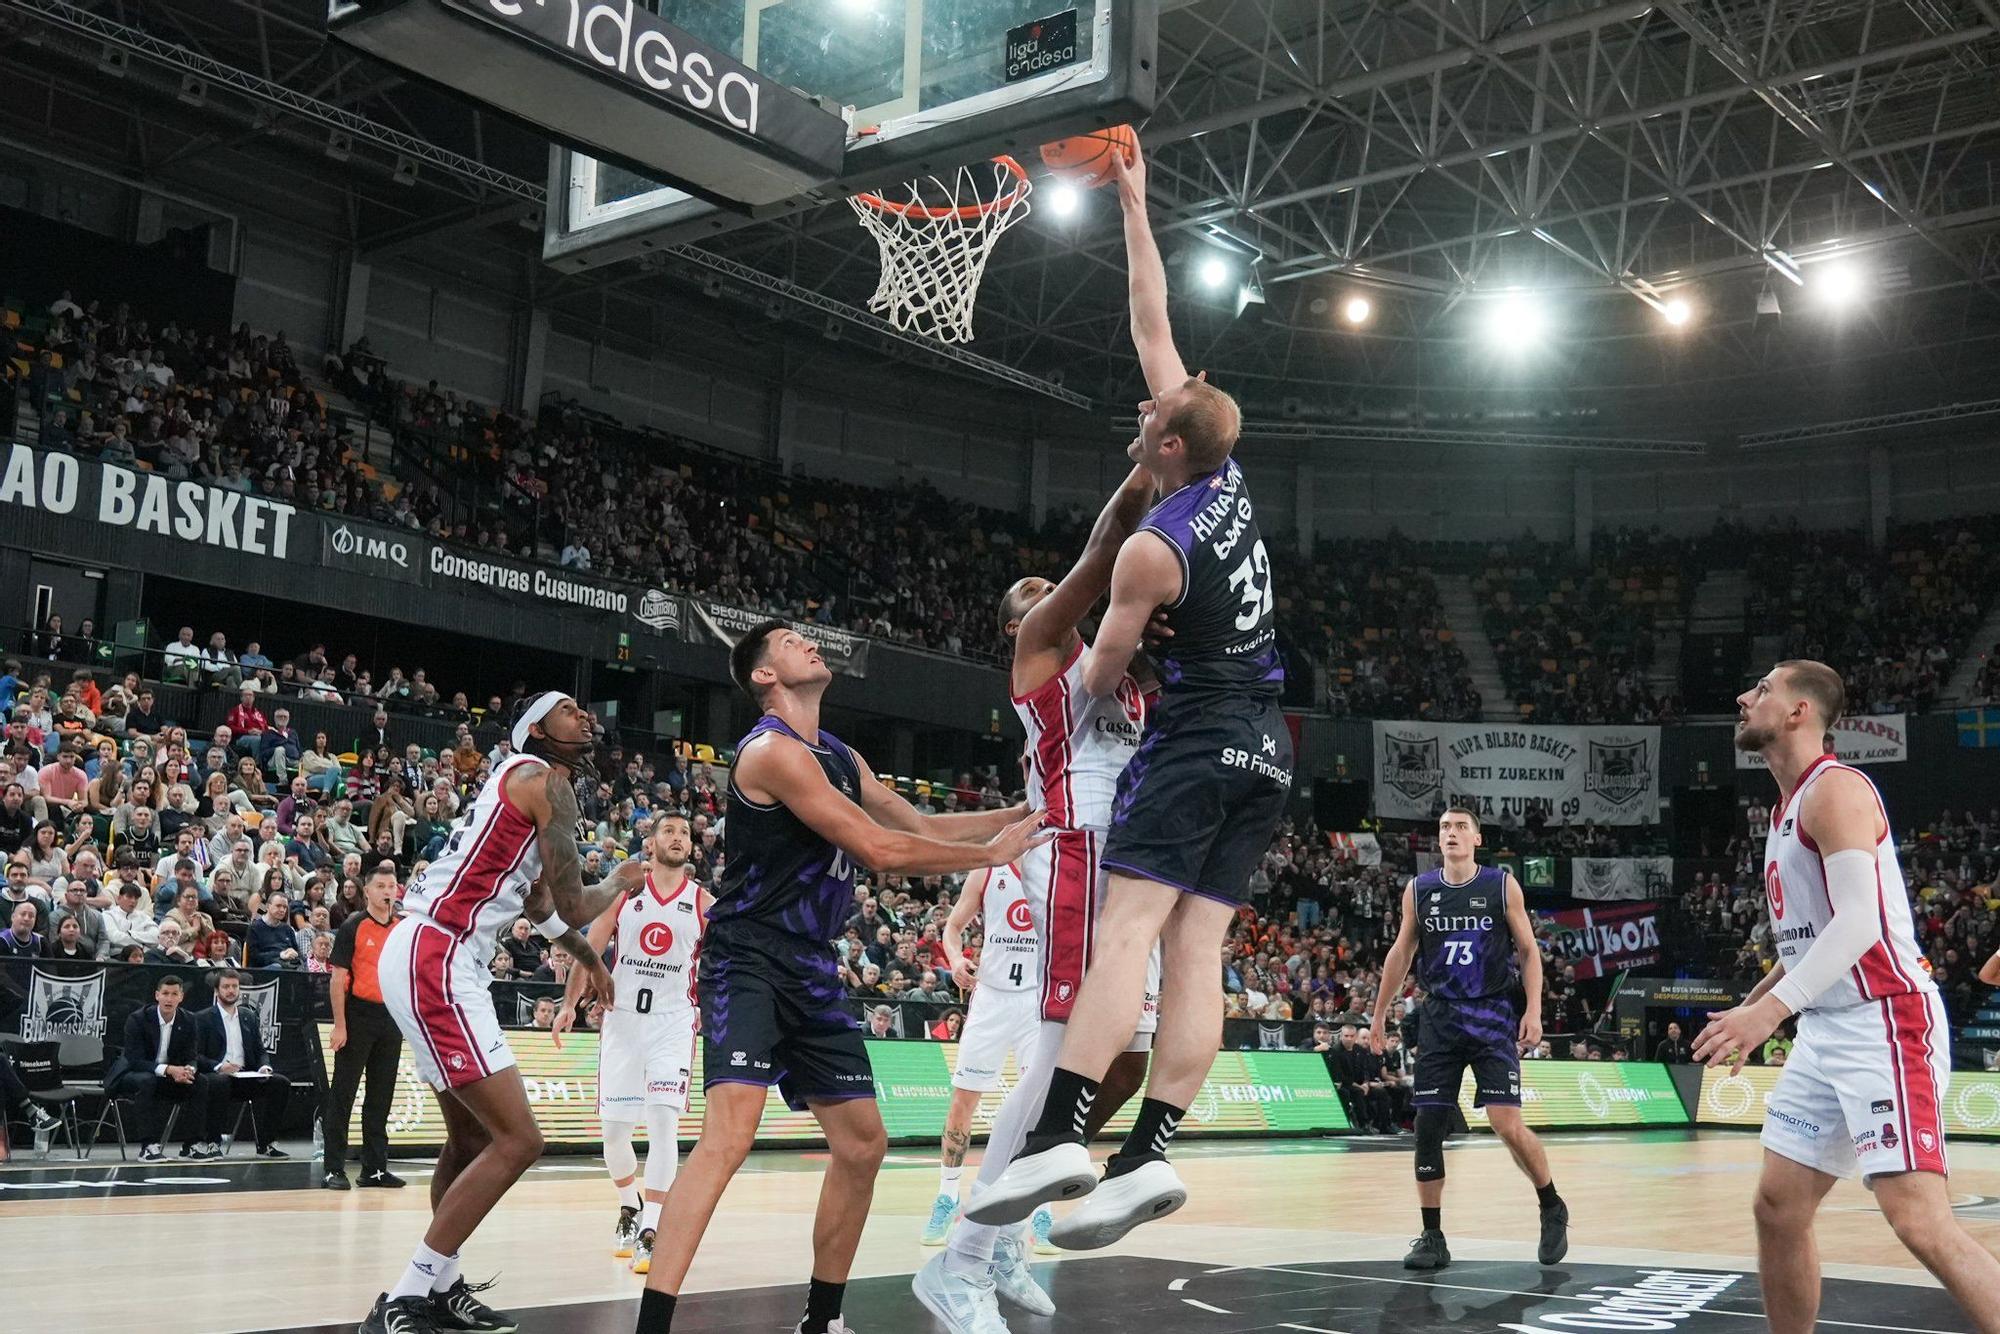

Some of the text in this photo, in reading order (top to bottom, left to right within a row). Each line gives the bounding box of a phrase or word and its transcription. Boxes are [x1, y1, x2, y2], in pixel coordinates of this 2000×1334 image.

[1007, 44, 1074, 77] endesa
[1008, 38, 1038, 62] liga
[99, 462, 296, 560] BASKET
[355, 535, 409, 568] IMQ
[430, 546, 628, 614] Conservas Cusumano
[1228, 538, 1273, 631] 32
[639, 596, 678, 618] Cusumano
[792, 620, 851, 644] BEOTIBAR
[617, 647, 629, 661] 21
[1449, 731, 1577, 762] AUPA BILBAO BASKET
[1864, 748, 1898, 759] ALONE
[1221, 747, 1250, 769] SR
[1460, 766, 1565, 780] BETI ZUREKIN
[1561, 797, 1580, 816] 09
[1424, 914, 1493, 933] surne
[620, 955, 683, 974] Casademont
[1444, 941, 1474, 966] 73
[634, 968, 665, 979] ZARAGOZA
[1009, 963, 1023, 986] 4
[636, 988, 653, 1015] 0
[890, 1083, 950, 1098] RENOVABLES
[1220, 1085, 1286, 1102] EKIDOM
[1872, 1105, 1889, 1114] acb
[1538, 1270, 1744, 1331] Occident
